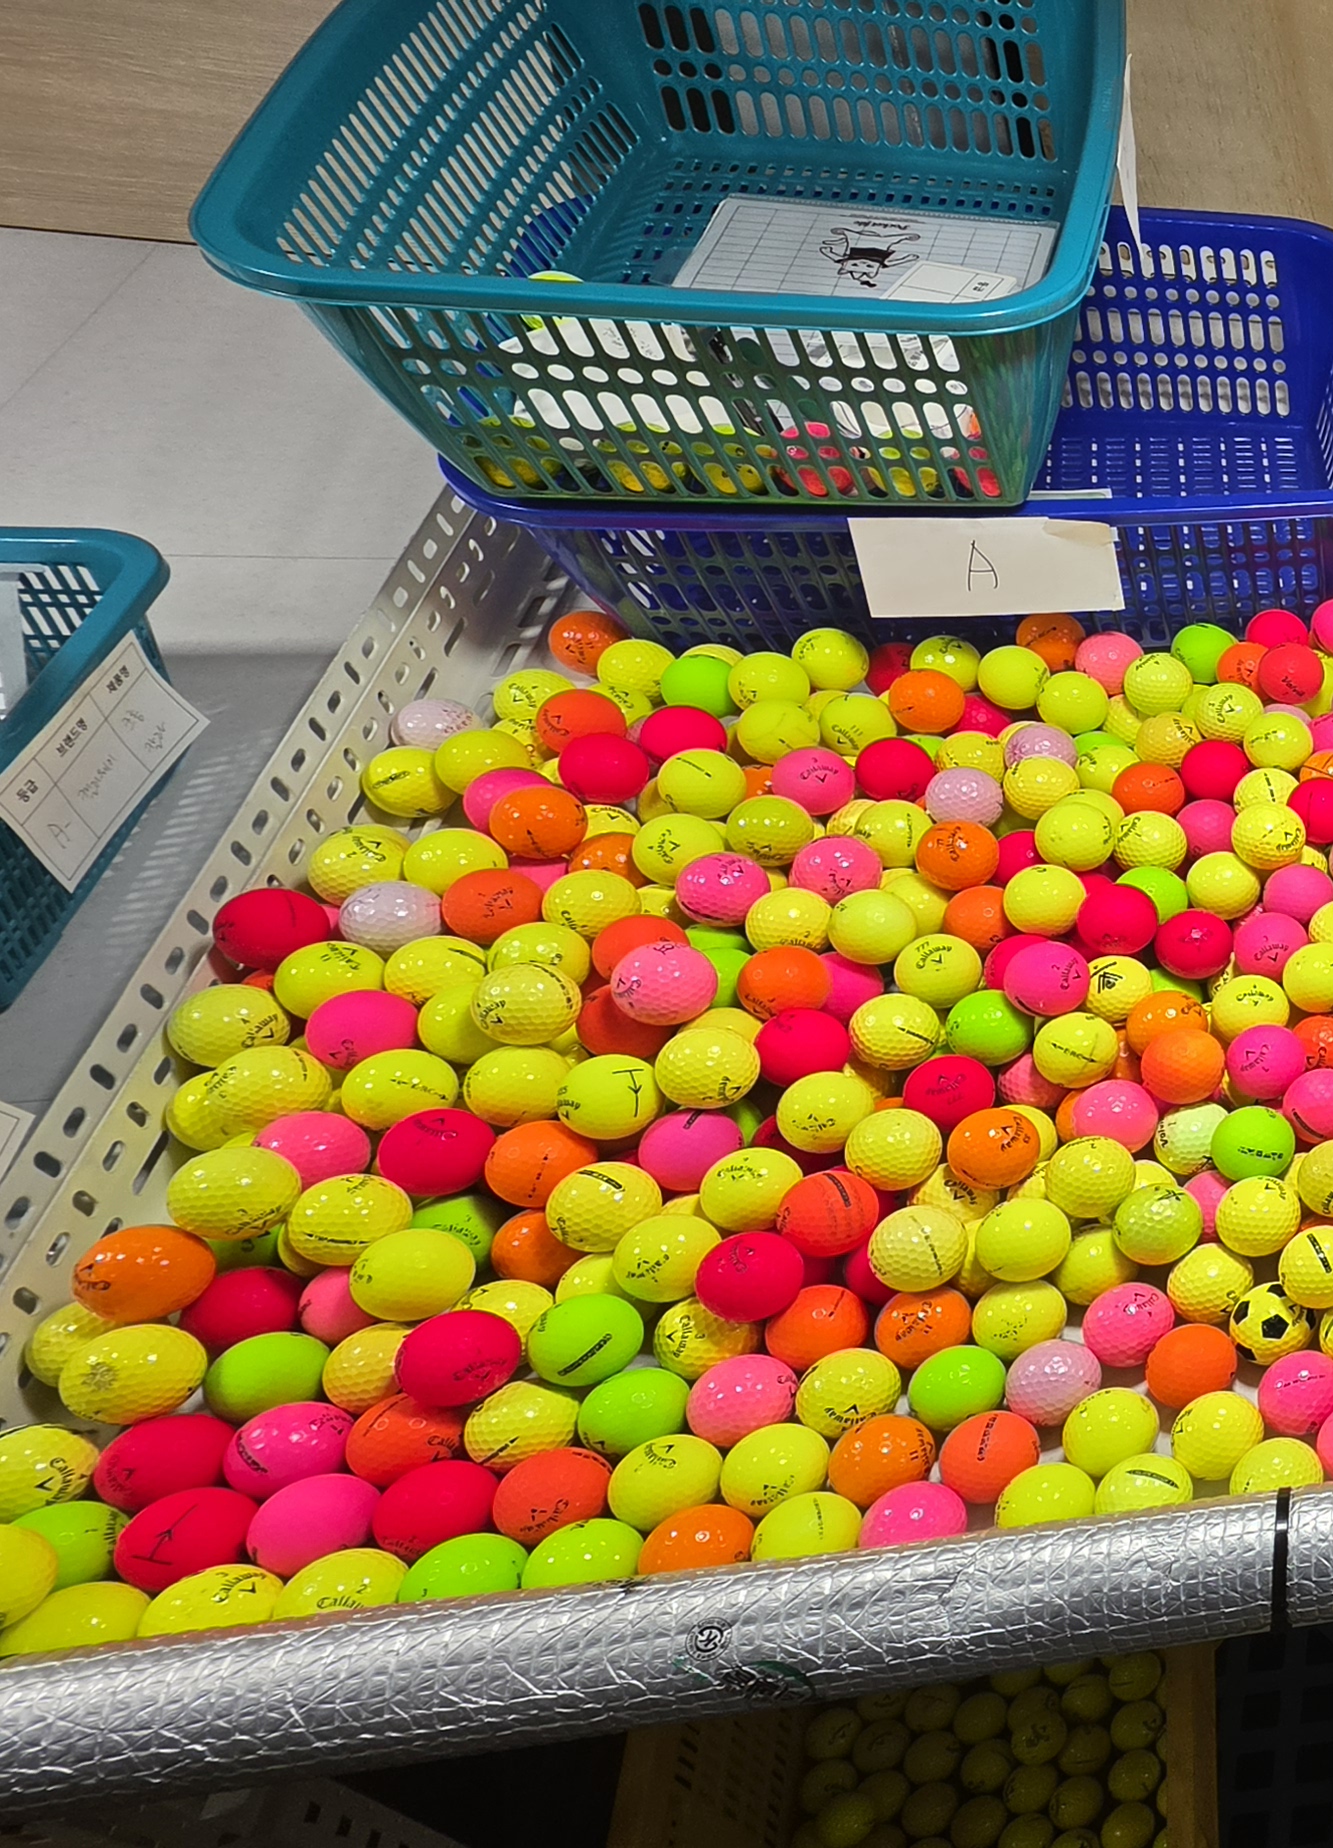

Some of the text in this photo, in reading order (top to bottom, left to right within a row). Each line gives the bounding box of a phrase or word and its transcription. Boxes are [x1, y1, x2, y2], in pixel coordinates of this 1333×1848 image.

[965, 538, 999, 592] A
[55, 717, 89, 758] 브랜드명
[105, 664, 131, 694] 제품명
[1206, 694, 1235, 723] Callaway
[799, 767, 840, 781] Callaway
[1116, 816, 1142, 843] Callaway
[1276, 829, 1302, 852] Callaway
[915, 945, 953, 971] Callaway
[1252, 942, 1290, 961] Callaway
[1059, 957, 1081, 991] Callaway
[1238, 1044, 1273, 1073] Callaway
[943, 1180, 976, 1205] Callaway
[672, 1314, 691, 1360] Callaway
[212, 1569, 266, 1603] Callaway
